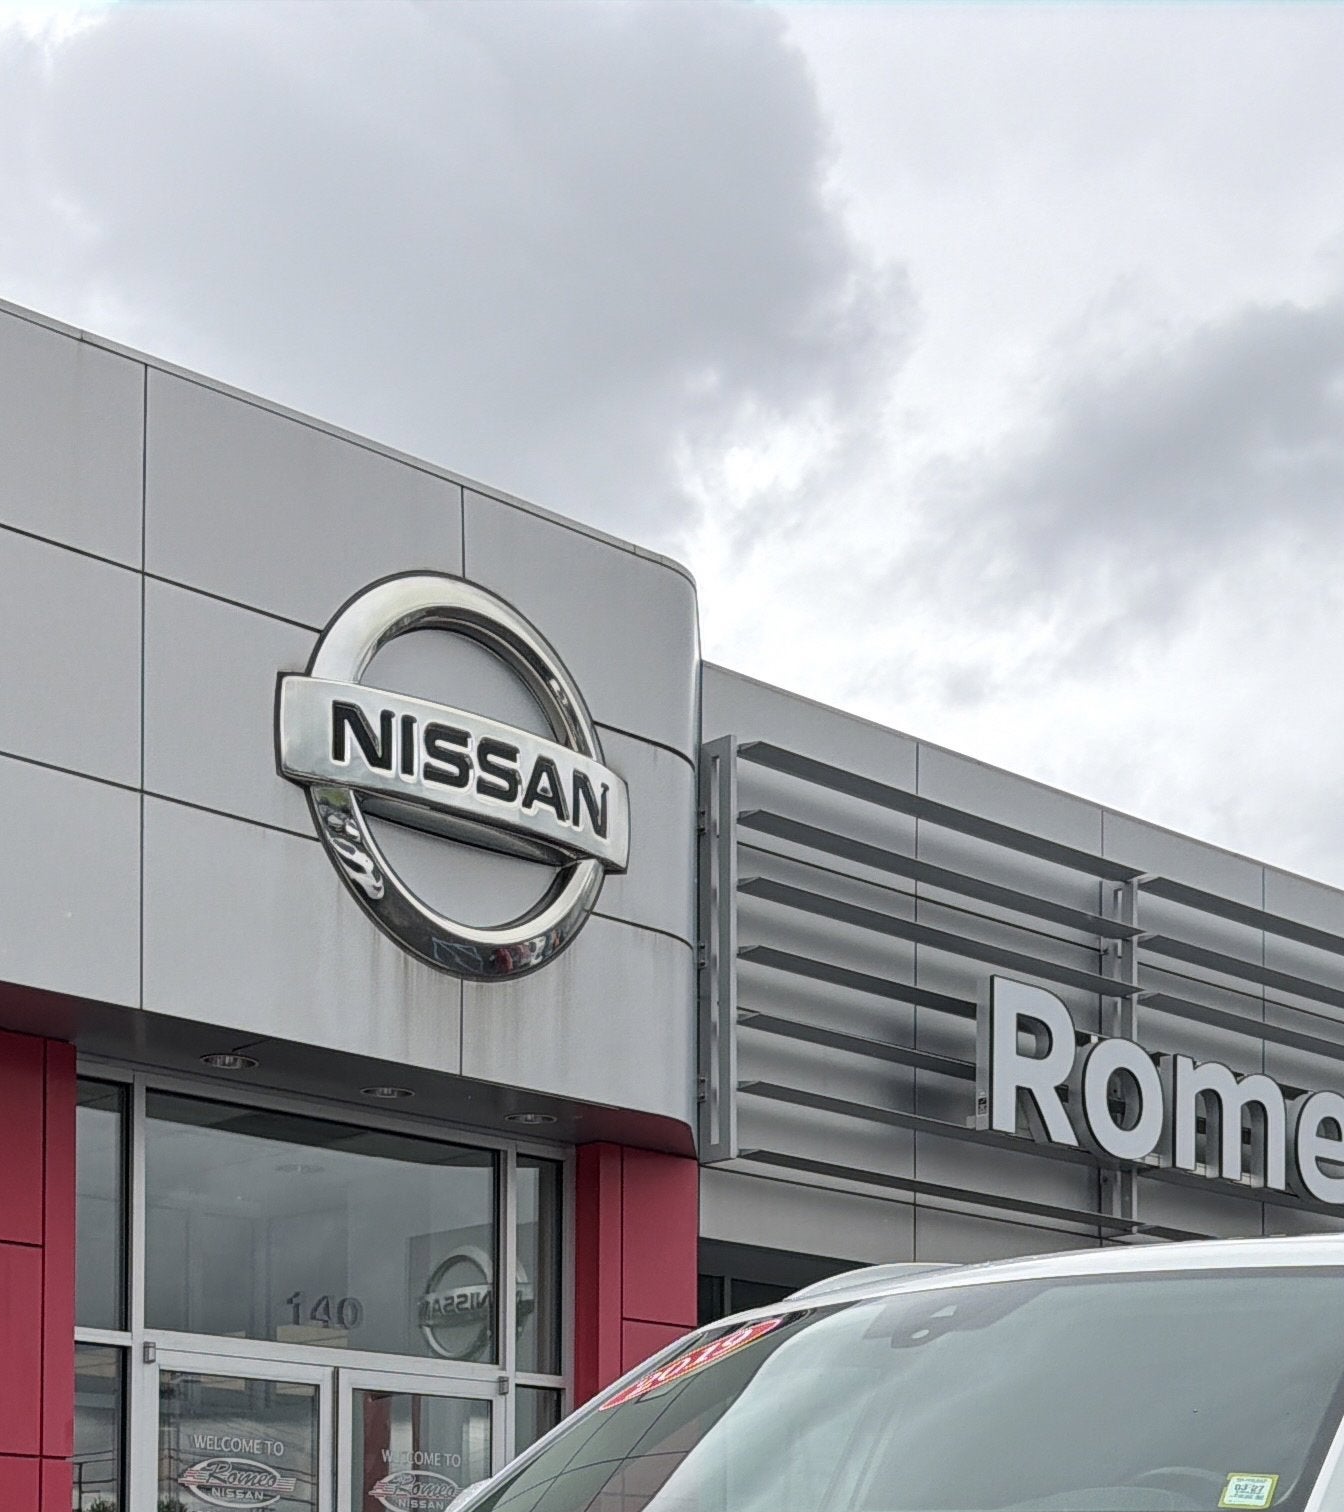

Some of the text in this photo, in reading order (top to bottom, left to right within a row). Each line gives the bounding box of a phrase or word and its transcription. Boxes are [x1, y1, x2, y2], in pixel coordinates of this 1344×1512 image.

[330, 698, 610, 840] NISSAN
[286, 1290, 361, 1330] 140
[193, 1434, 284, 1456] WELCOME TO
[444, 1453, 461, 1468] TO
[205, 1461, 278, 1488] Romeo
[211, 1487, 264, 1501] NISSAN
[397, 1499, 444, 1511] NISSAN
